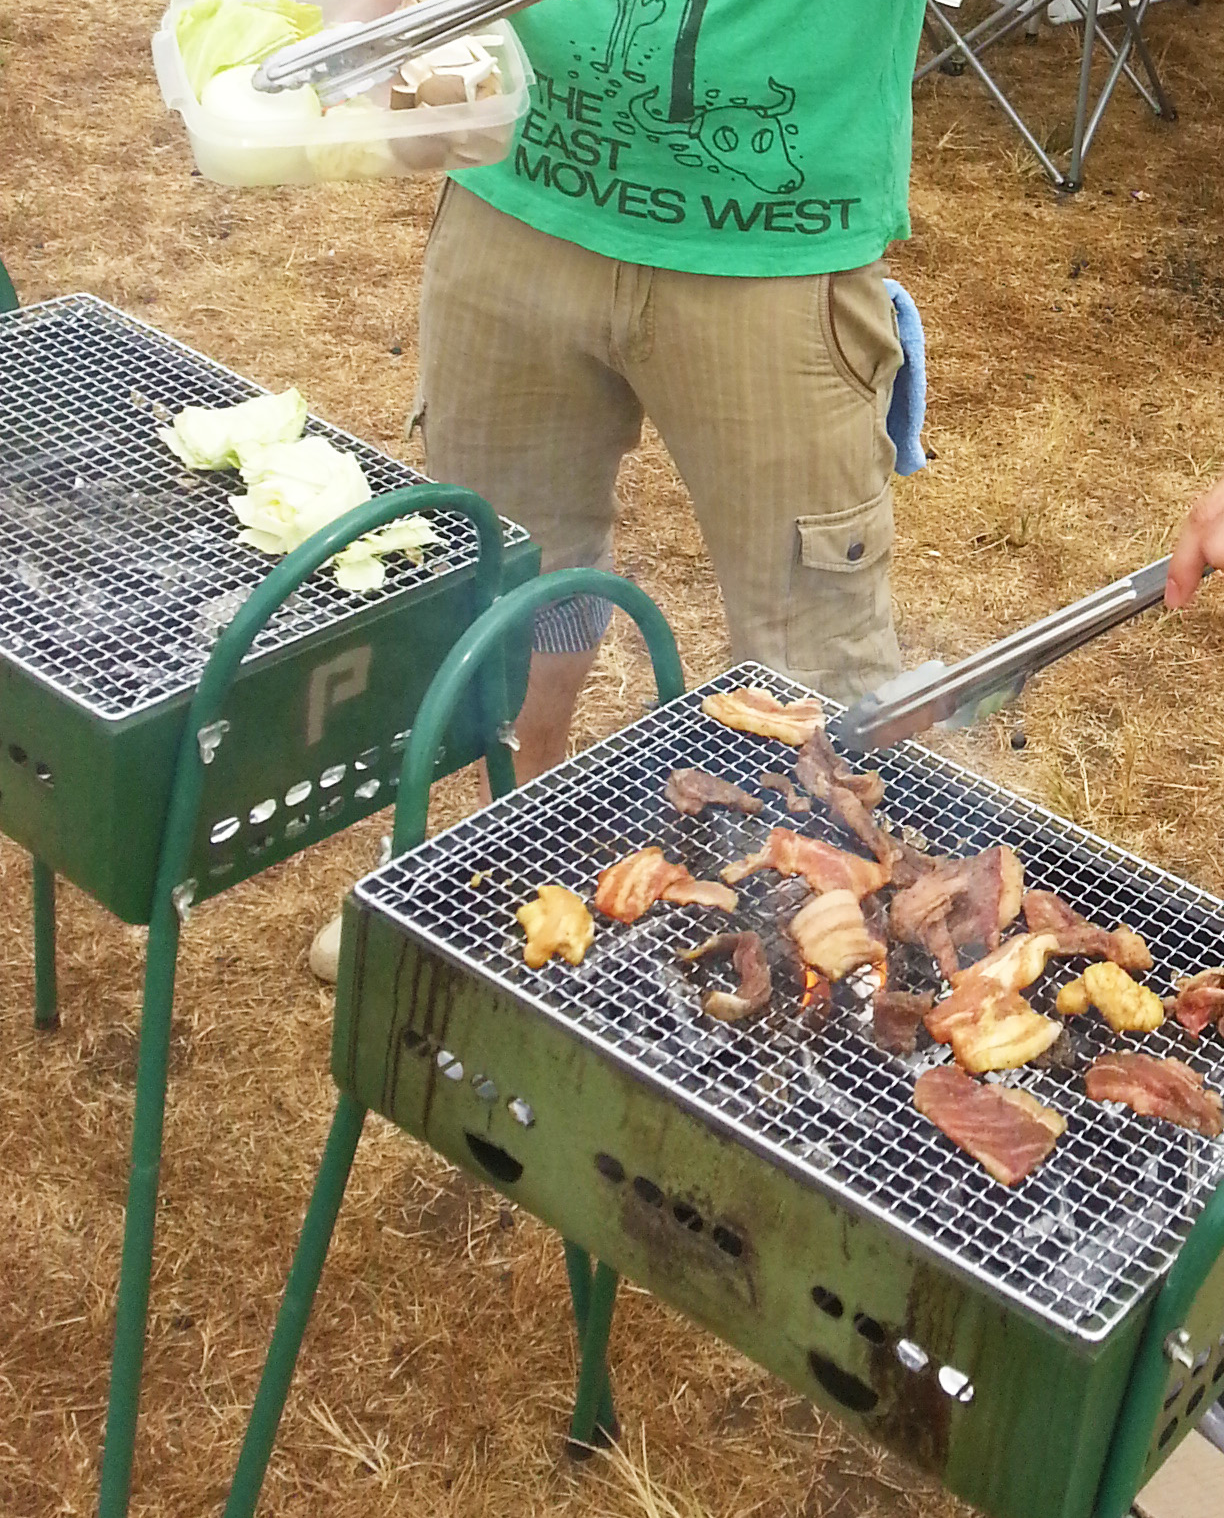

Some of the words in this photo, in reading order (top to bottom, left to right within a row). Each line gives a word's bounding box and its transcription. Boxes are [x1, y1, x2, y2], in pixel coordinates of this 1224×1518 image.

[533, 70, 604, 128] THE
[522, 108, 632, 171] EAST
[514, 145, 687, 224] MOVES
[701, 195, 862, 235] WEST
